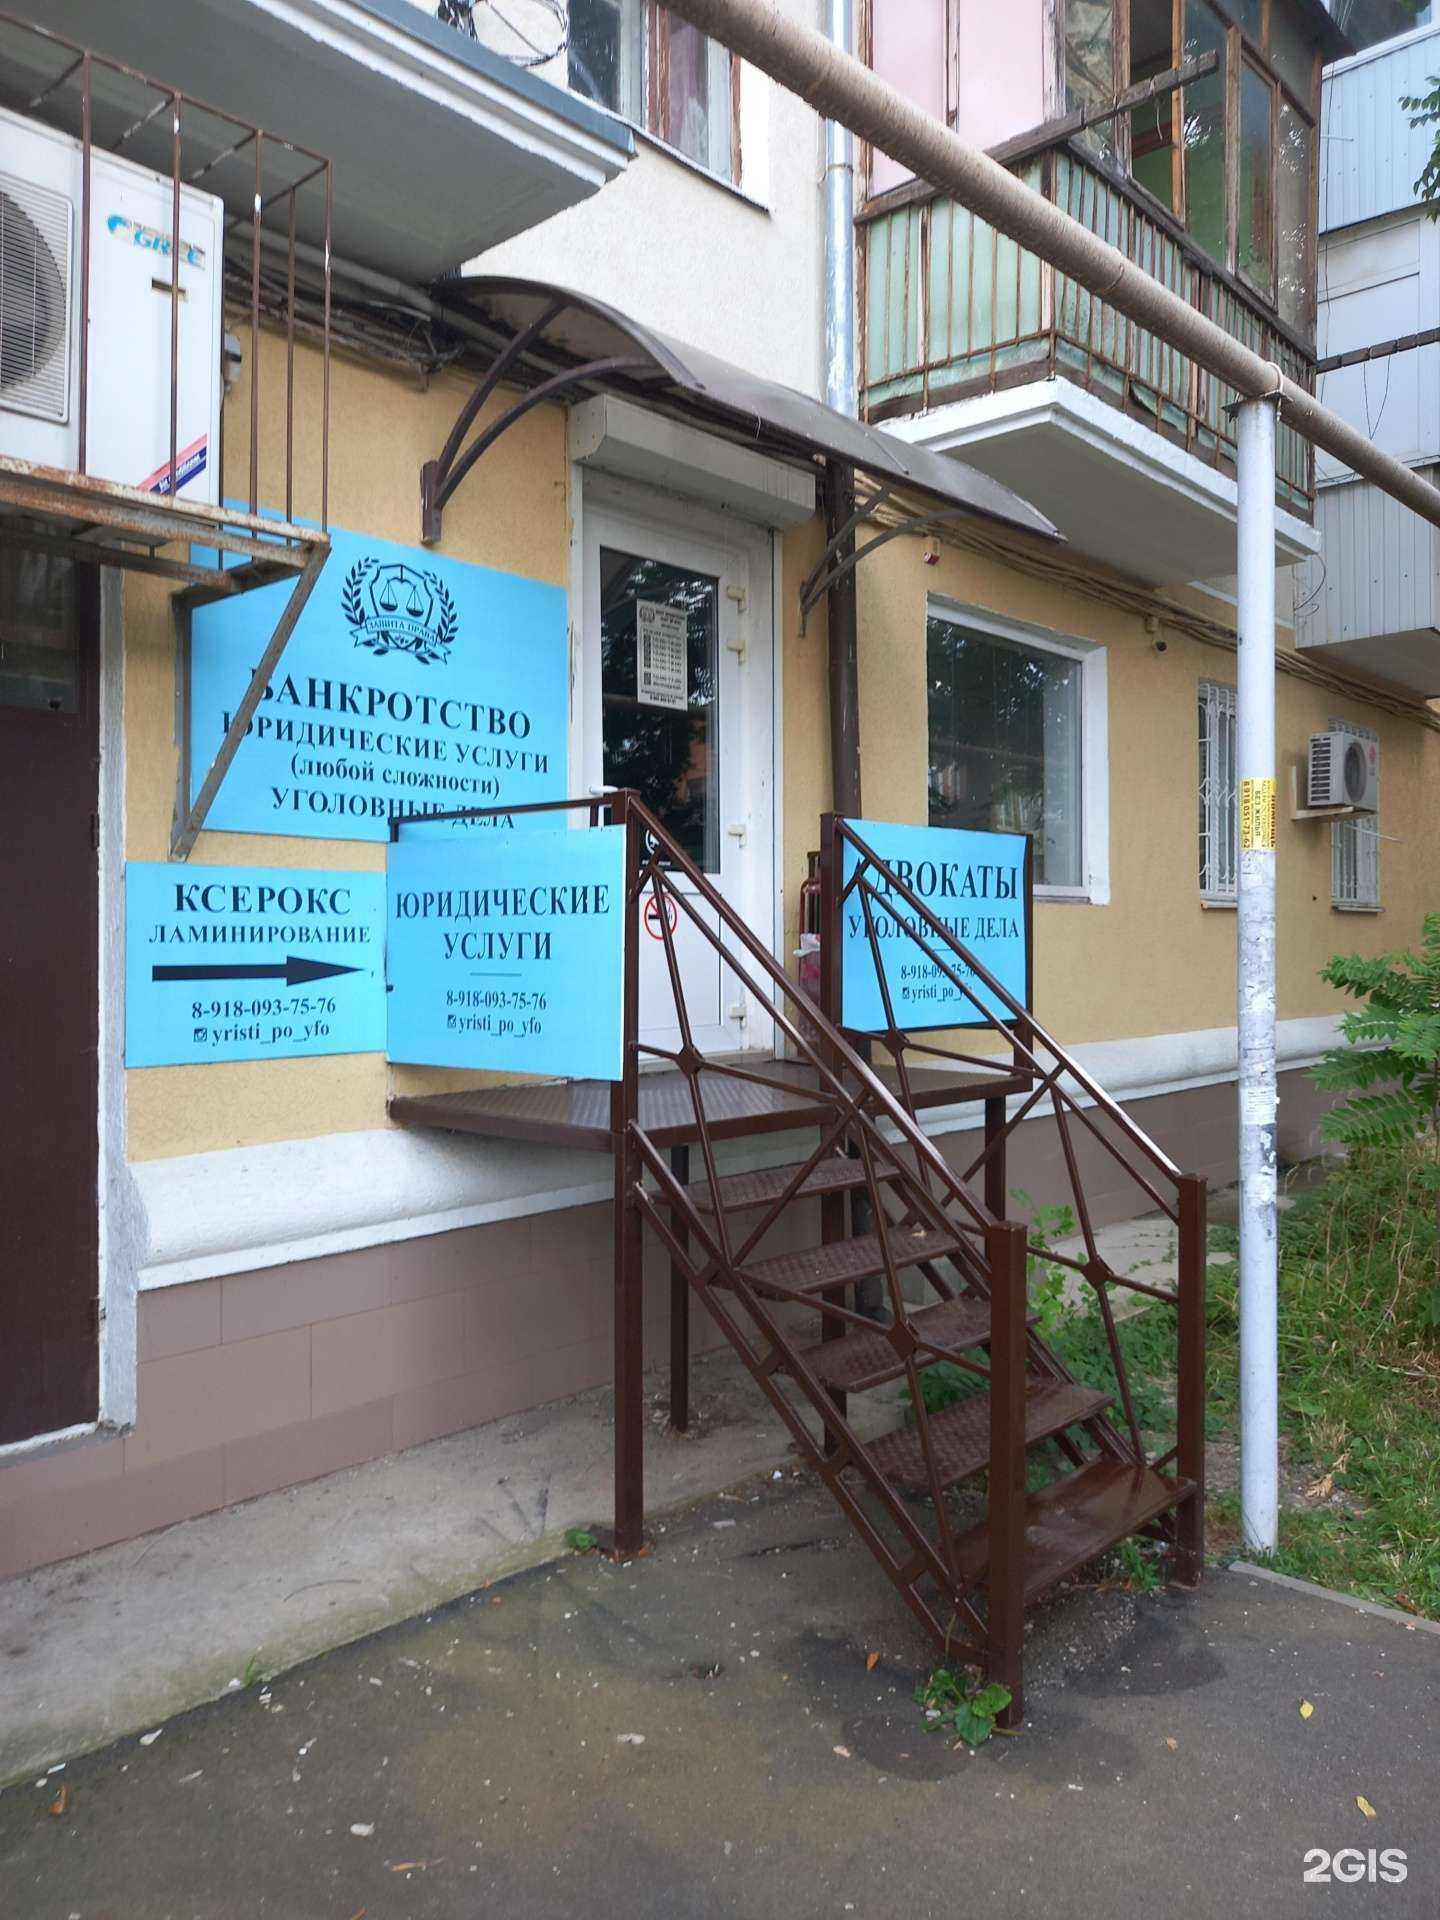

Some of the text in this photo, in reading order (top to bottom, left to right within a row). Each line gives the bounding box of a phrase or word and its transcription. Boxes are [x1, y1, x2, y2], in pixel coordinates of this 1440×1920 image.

[368, 618, 405, 633] ЗАЩИТА
[456, 742, 549, 774] УСЛУГИ
[291, 752, 500, 798] (любой сложности)
[174, 883, 352, 916] КСЕРОКС
[396, 884, 611, 924] ЮРИДИЧЕСКИЕ
[149, 923, 371, 944] ЛАМИНИРОВАНИЕ
[974, 916, 1019, 942] ДЕЛА
[443, 931, 553, 961] УСЛУГИ
[191, 996, 336, 1020] 8-918-093-75-76
[446, 989, 548, 1011] 8-918-093-75-76
[213, 1023, 330, 1046] yristi_po_yfo
[457, 1013, 543, 1038] yristi_po_yfo
